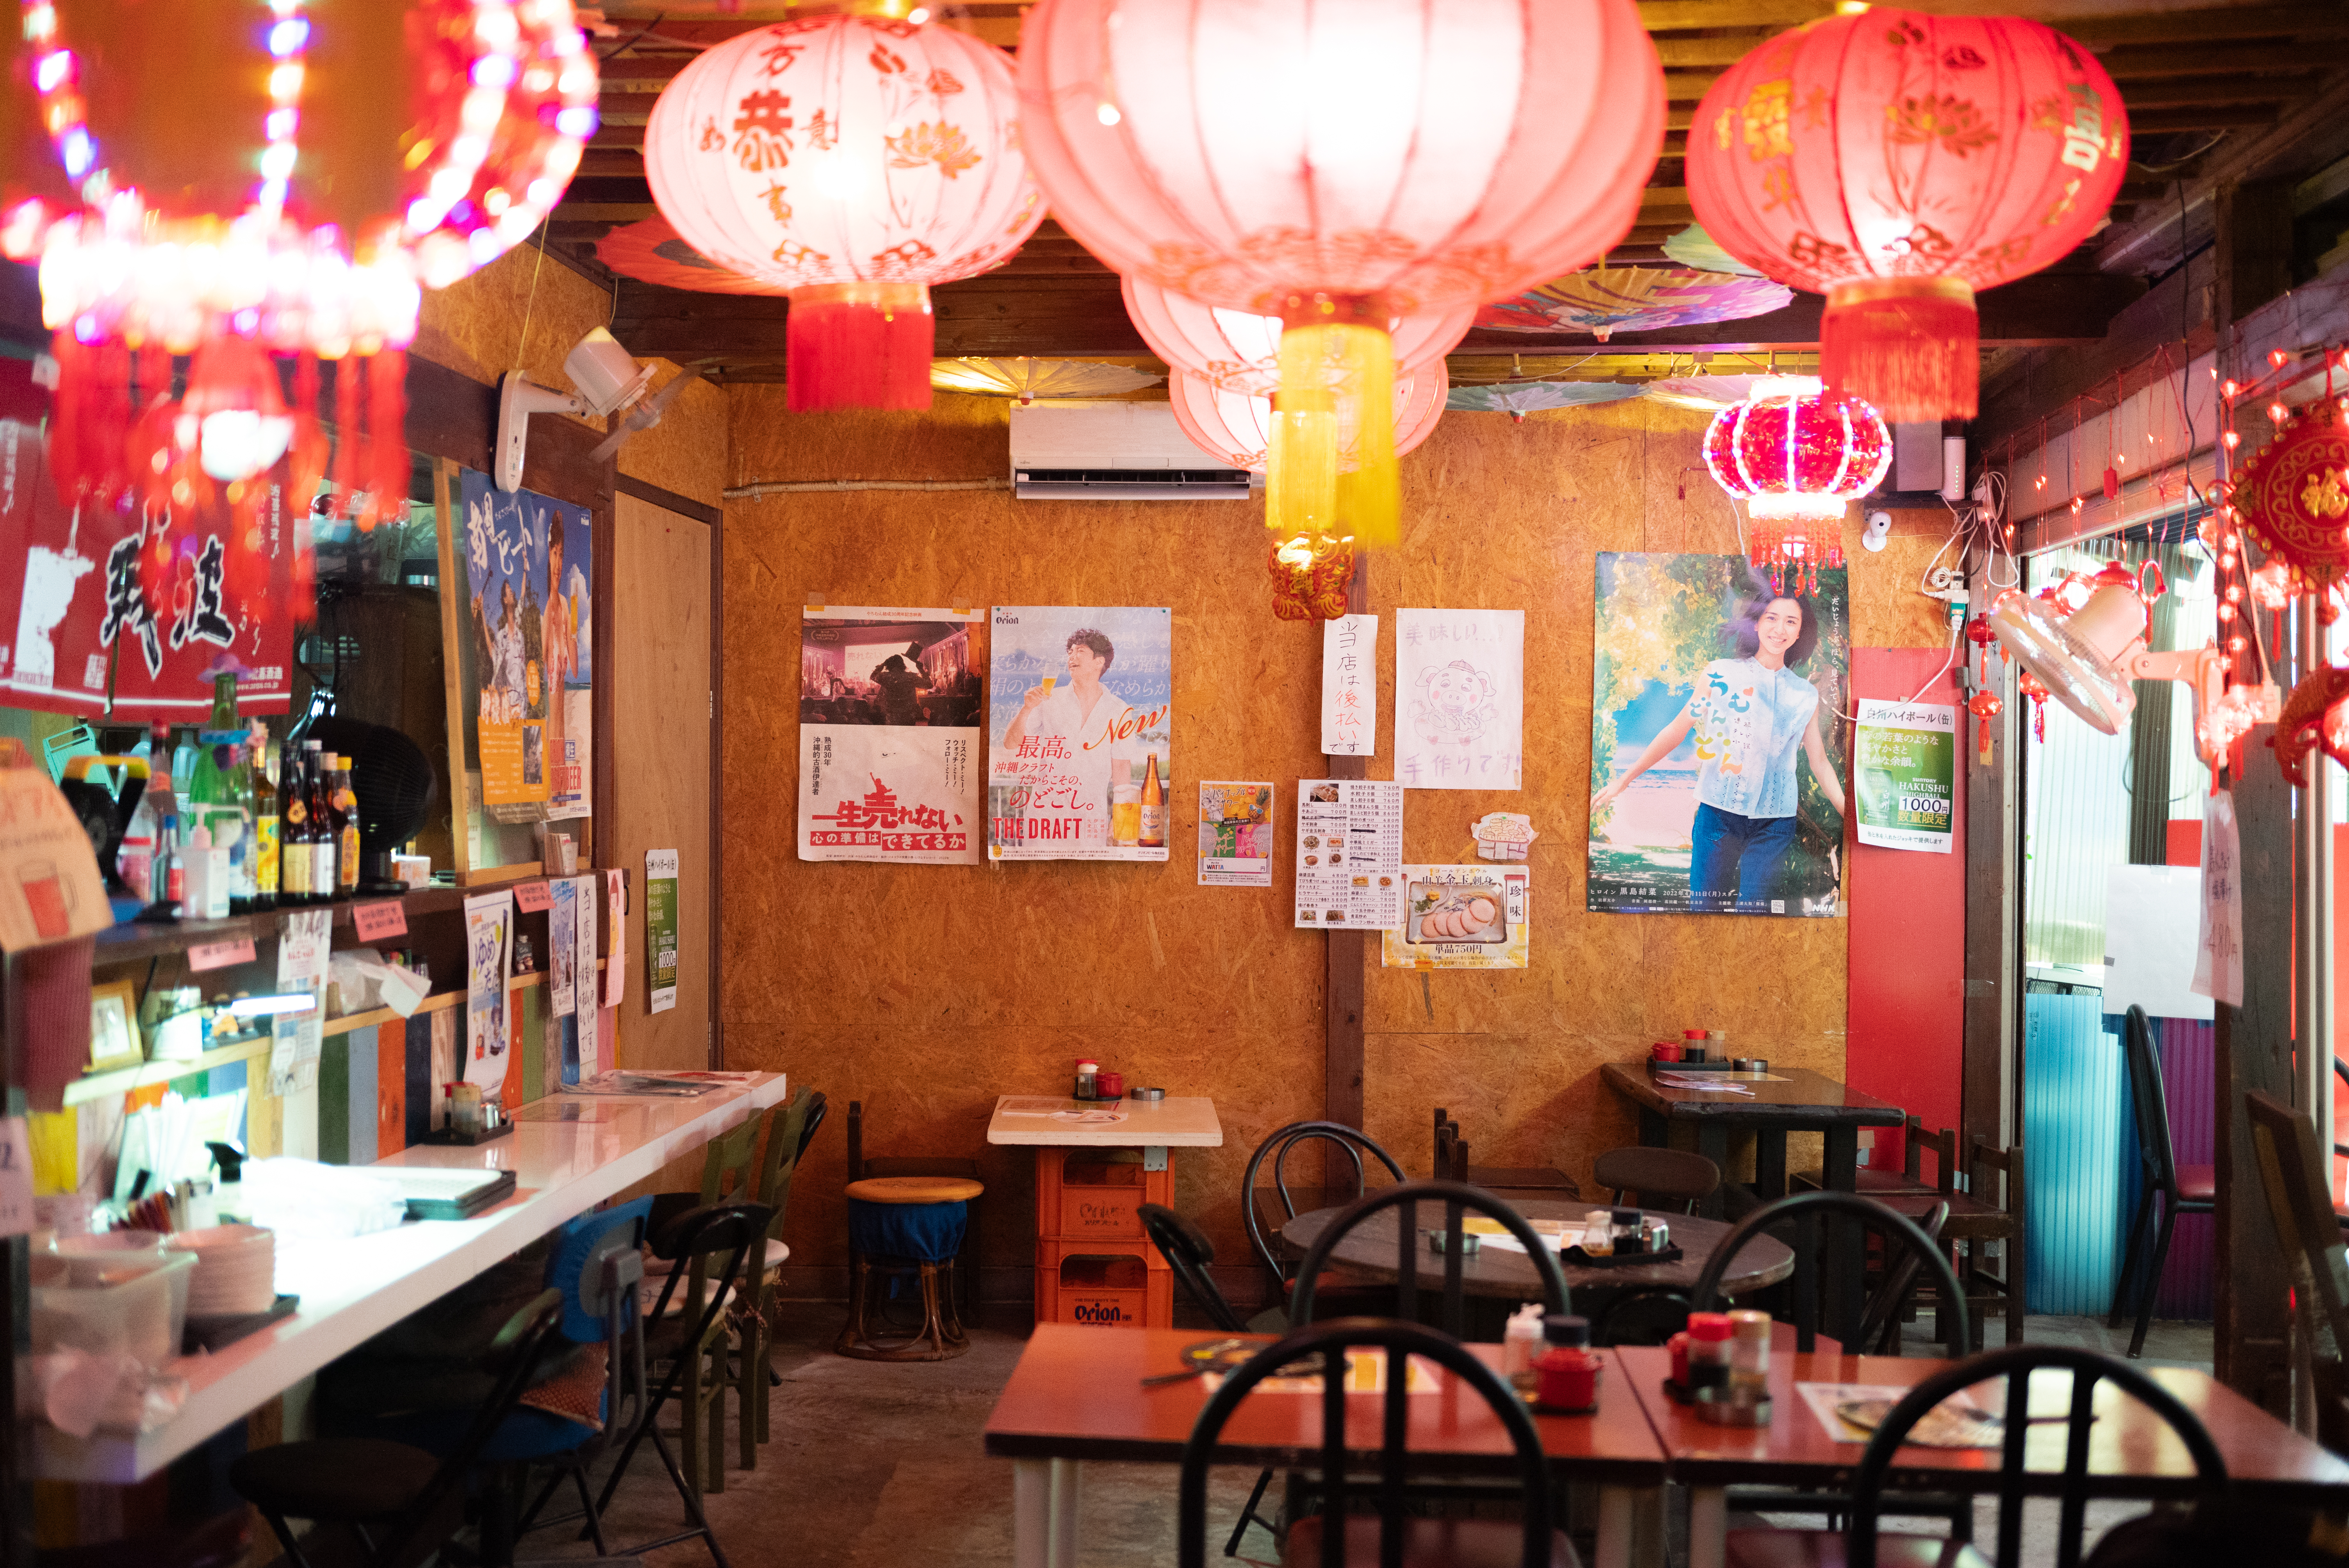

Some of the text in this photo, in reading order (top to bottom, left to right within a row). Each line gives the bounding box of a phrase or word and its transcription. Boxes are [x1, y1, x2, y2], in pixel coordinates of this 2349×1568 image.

[1329, 622, 1361, 753] 当店は後払いです
[1083, 705, 1167, 750] New
[1862, 730, 1939, 745] 森の若葉のような
[1016, 735, 1071, 759] 最高。
[995, 761, 1055, 773] 沖縄クラフト
[1899, 782, 1948, 793] HAKUSHU
[1010, 789, 1094, 811] のどごし。
[1902, 798, 1948, 813] 1000円
[812, 794, 963, 830] 一生売れない
[1897, 810, 1947, 825] 数量限定
[993, 818, 1082, 839] THE DRAFT
[812, 832, 965, 849] 心の準備は できてるか
[1422, 874, 1493, 886] 山羊金玉刺身
[1620, 887, 1657, 896] 黒島結菜
[1510, 886, 1521, 917] 珍味
[1436, 944, 1482, 954] 単品750円
[1075, 1303, 1120, 1322] Orion
